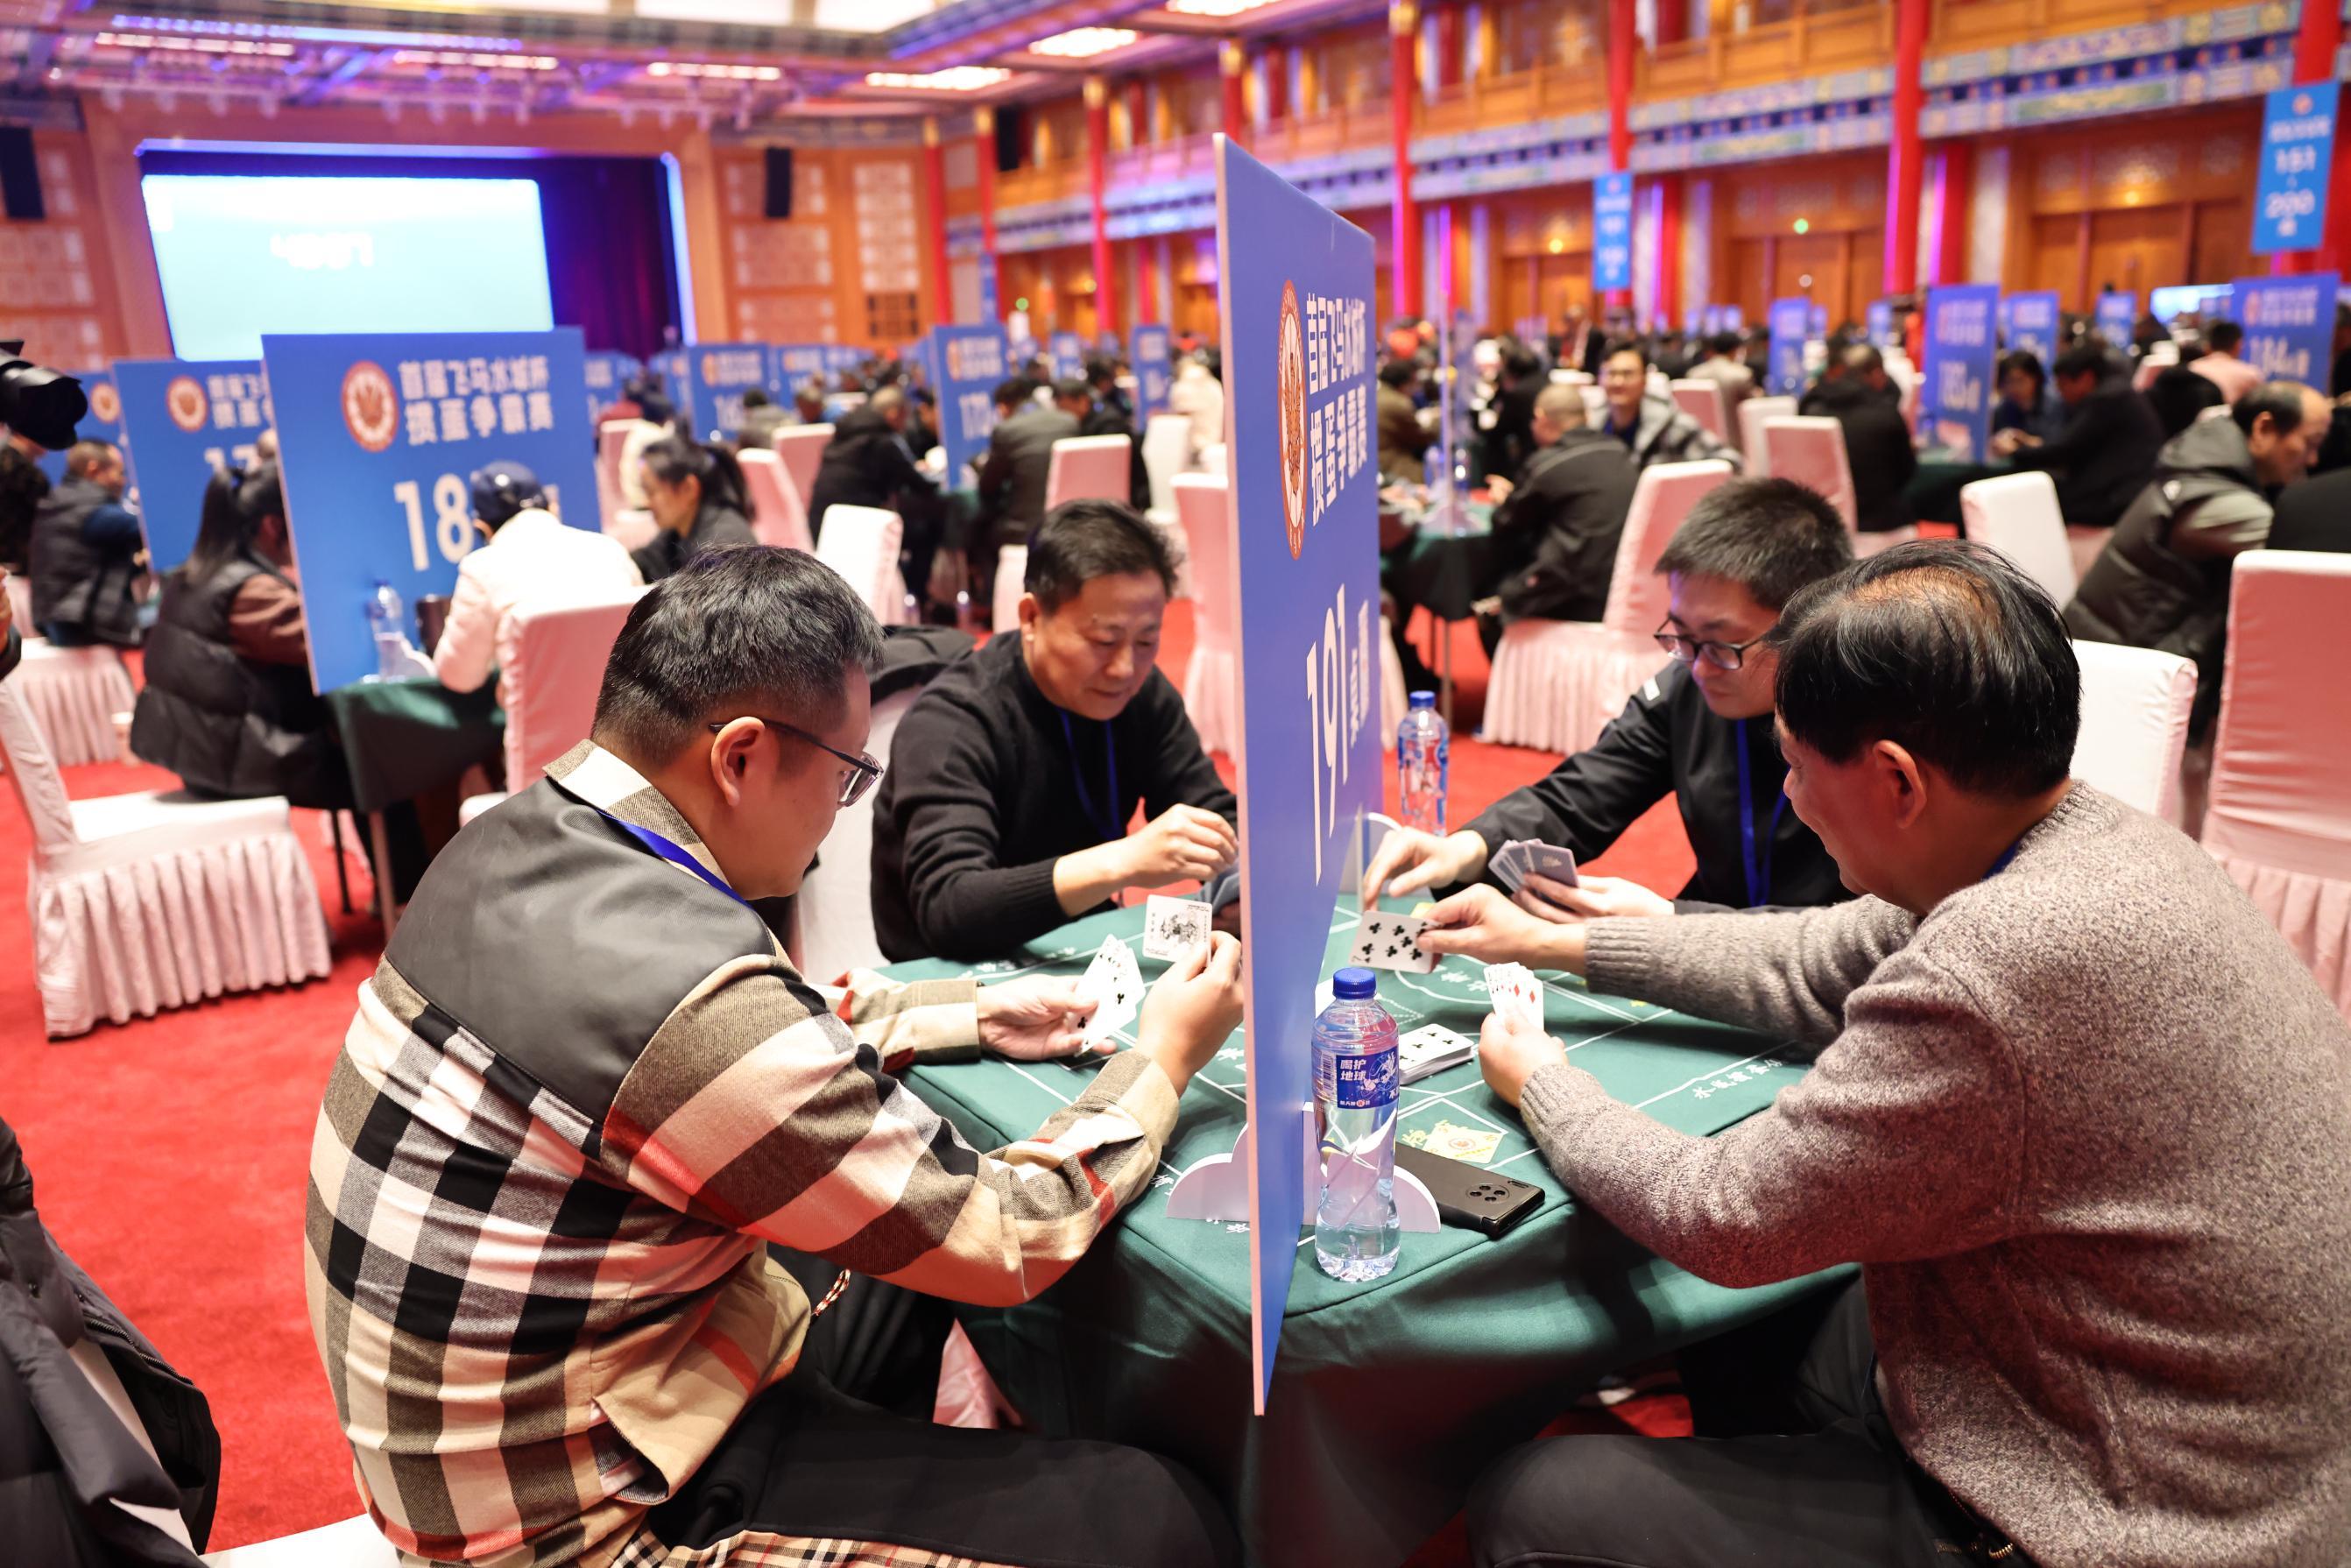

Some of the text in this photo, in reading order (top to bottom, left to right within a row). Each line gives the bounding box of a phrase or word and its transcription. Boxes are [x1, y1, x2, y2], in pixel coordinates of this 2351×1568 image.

[394, 473, 484, 572] 18
[1339, 1059, 1367, 1070] 喝护
[1339, 1070, 1367, 1082] 地球
